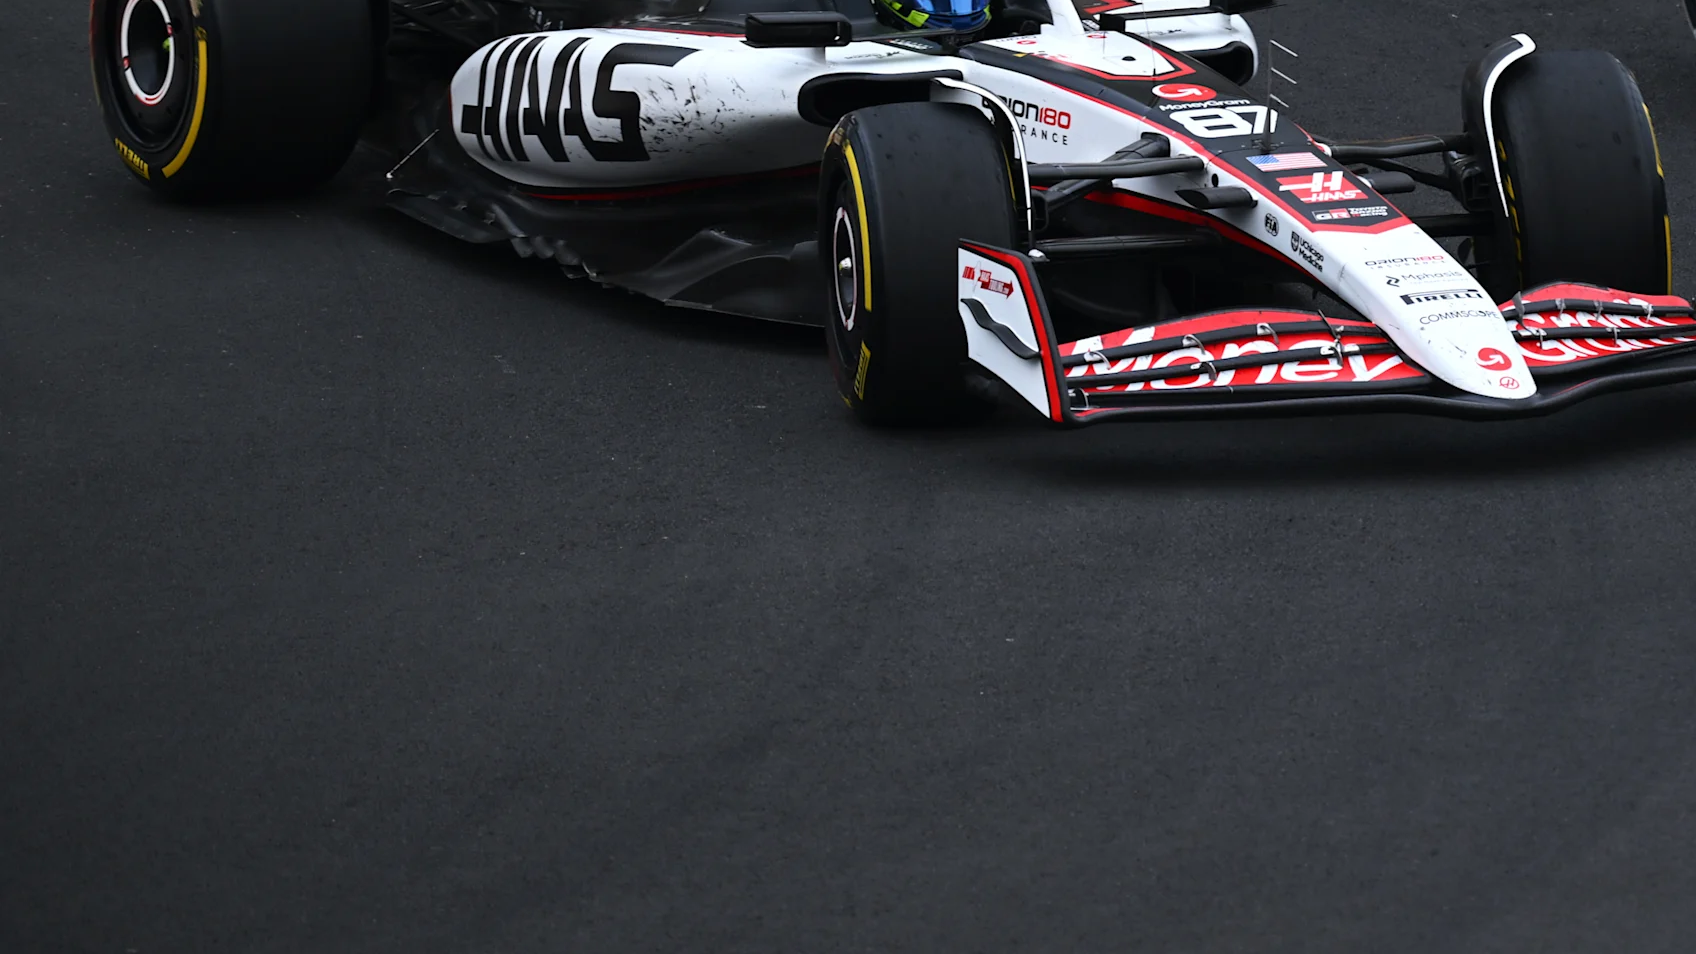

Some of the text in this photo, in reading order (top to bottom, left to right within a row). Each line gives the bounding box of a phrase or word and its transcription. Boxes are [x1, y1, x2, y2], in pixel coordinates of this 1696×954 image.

[460, 36, 705, 162] HAAS
[1159, 99, 1251, 112] MoneyGram
[1169, 105, 1279, 139] 87
[1300, 189, 1363, 202] HAAS
[1364, 254, 1445, 267] ORION180
[1400, 269, 1463, 283] Mphasis
[1399, 288, 1484, 306] PIRELLI
[1418, 309, 1501, 326] COMMSCOPE
[1062, 326, 1405, 392] Money
